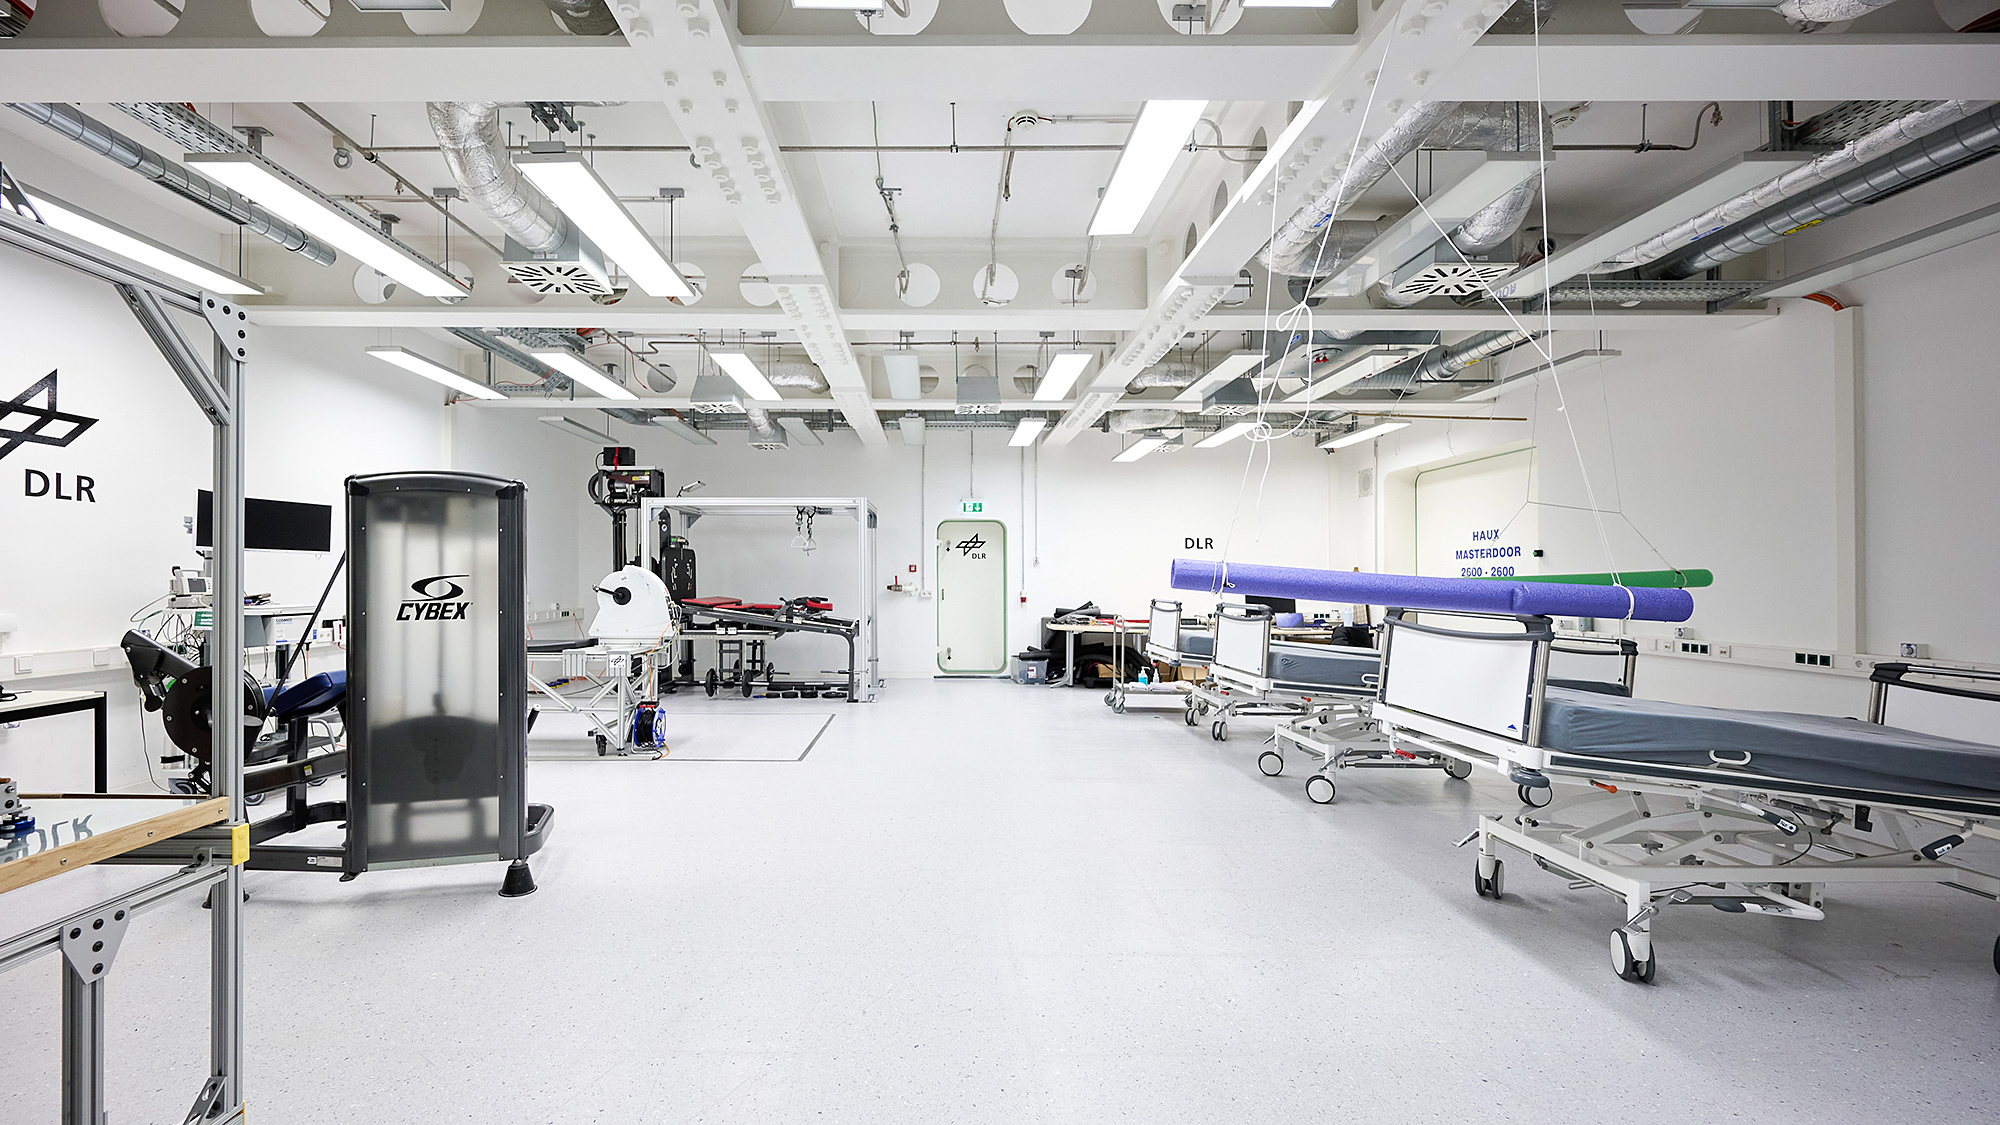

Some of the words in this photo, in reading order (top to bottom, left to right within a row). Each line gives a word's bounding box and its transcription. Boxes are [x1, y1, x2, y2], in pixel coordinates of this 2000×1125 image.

[25, 468, 96, 503] DLR
[1472, 529, 1500, 541] HAUX
[1185, 537, 1214, 550] DLR
[971, 552, 987, 560] DLR
[1455, 546, 1521, 560] MASTERDOOR
[1461, 567, 1483, 577] 2600
[1490, 566, 1515, 577] 2600
[396, 602, 470, 621] CYBEX
